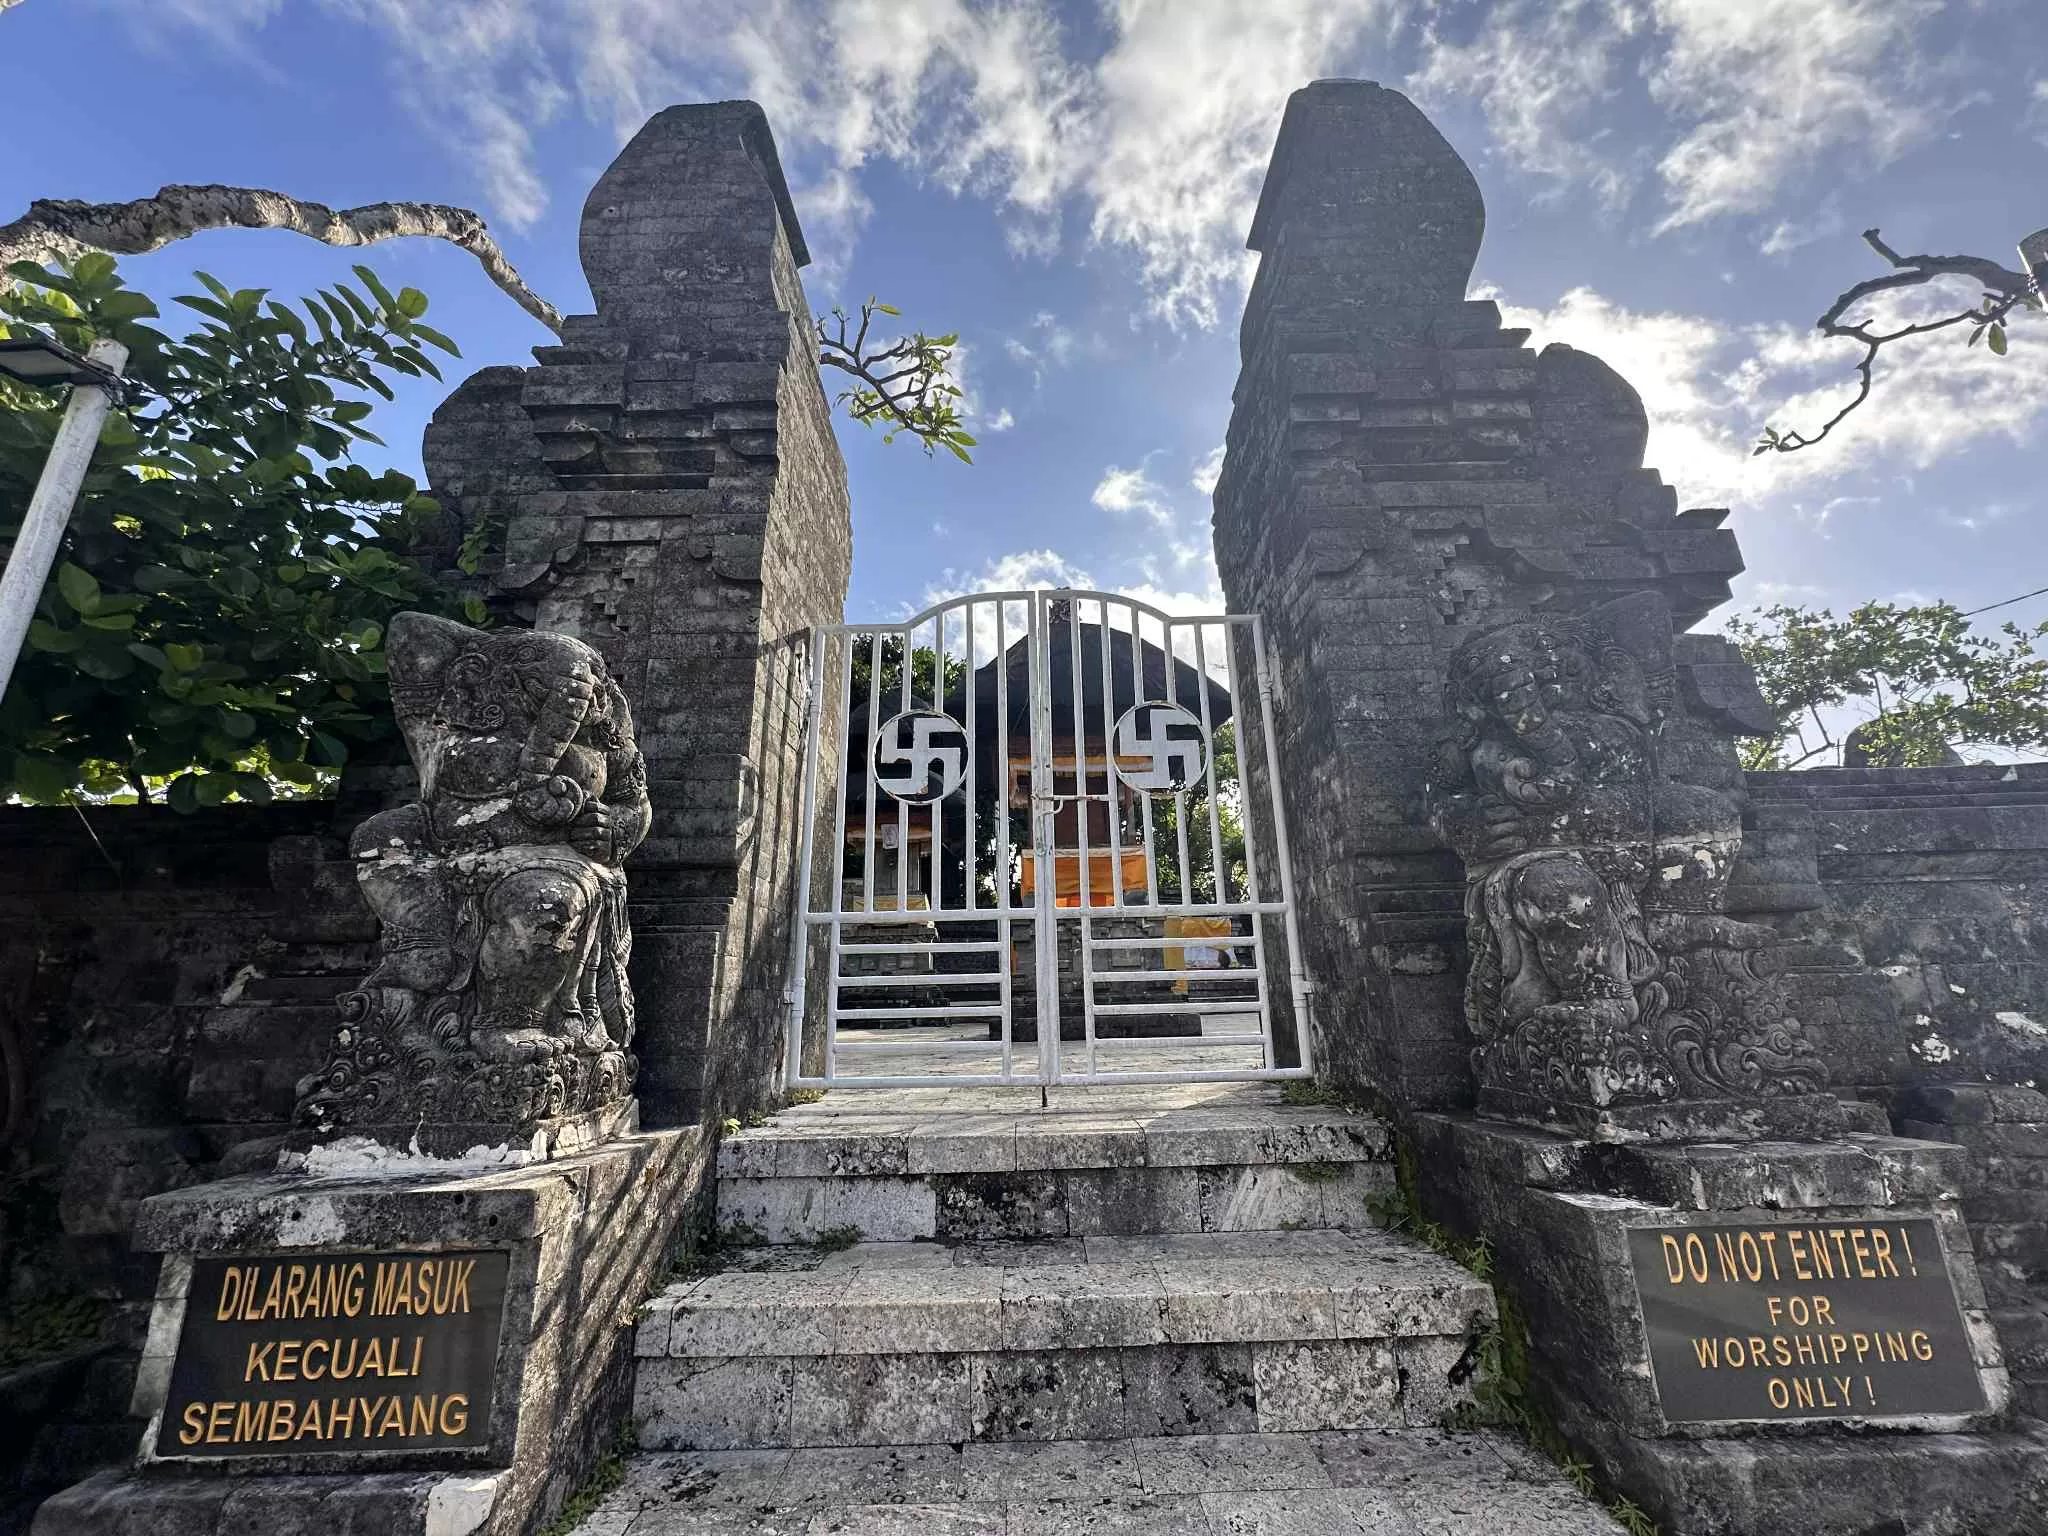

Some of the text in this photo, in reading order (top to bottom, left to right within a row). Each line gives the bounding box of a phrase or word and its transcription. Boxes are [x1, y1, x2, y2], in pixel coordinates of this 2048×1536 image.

[1661, 1232, 1708, 1284] DO
[1714, 1230, 1781, 1283] NOT
[1787, 1227, 1900, 1281] ENTER
[216, 1260, 475, 1320] DILARANG MASUK
[1767, 1295, 1836, 1327] FOR
[244, 1336, 424, 1382] KECUALI
[1693, 1330, 1933, 1368] WORSHIPPING
[1767, 1374, 1853, 1409] ONLY
[179, 1394, 469, 1444] SEMBAHYANG
